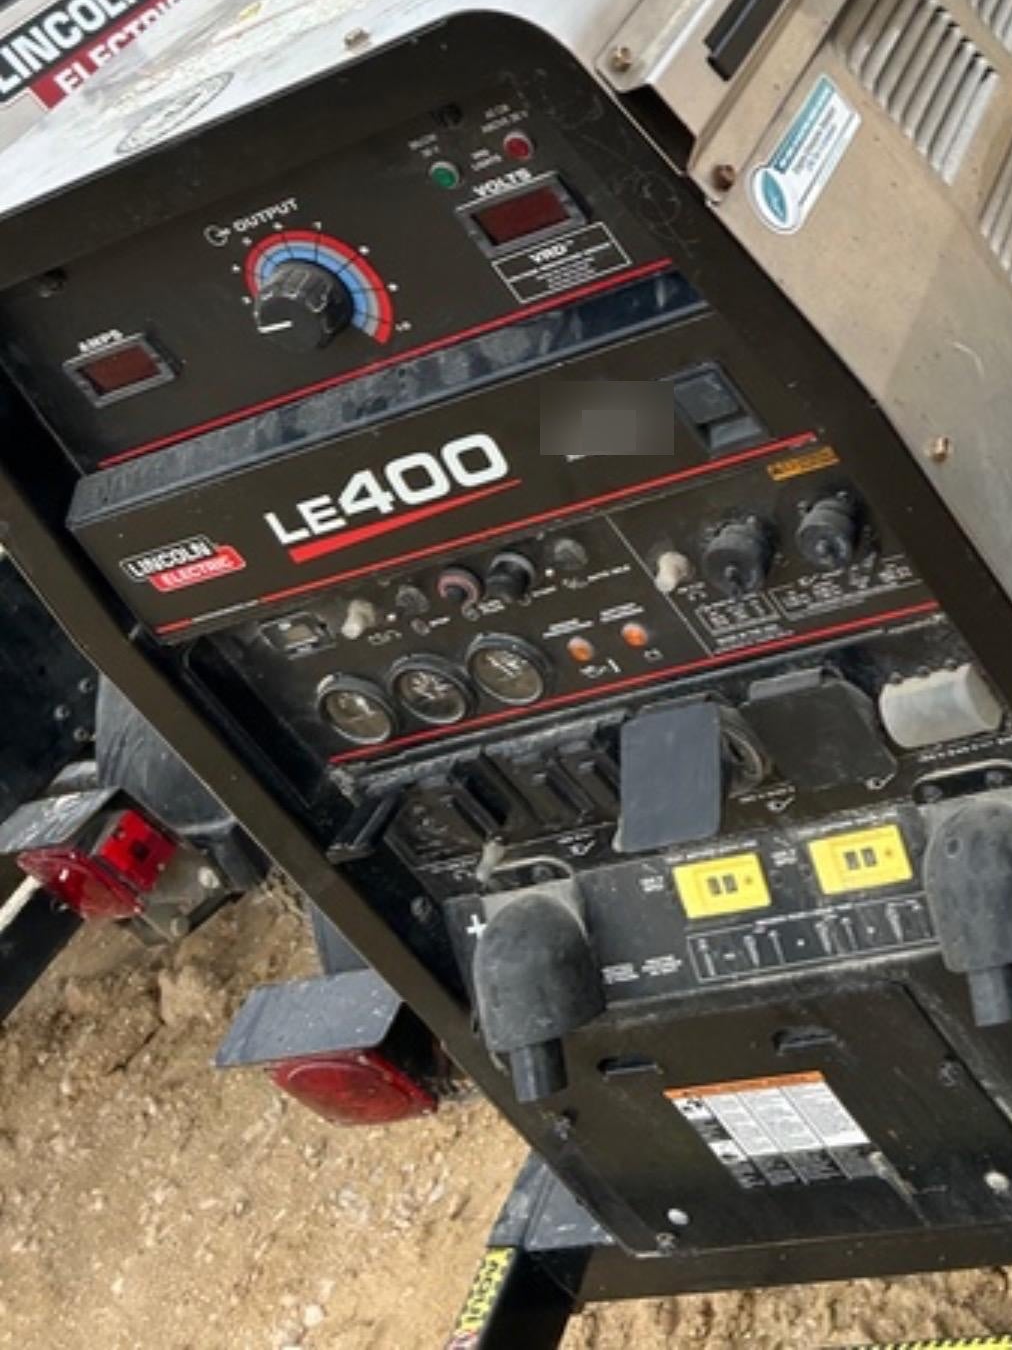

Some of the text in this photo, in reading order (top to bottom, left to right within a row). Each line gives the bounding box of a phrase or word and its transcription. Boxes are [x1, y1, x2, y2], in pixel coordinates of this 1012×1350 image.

[232, 197, 299, 233] OUTPUT
[263, 433, 509, 545] LE400
[129, 538, 213, 578] LINCOLN
[160, 555, 235, 587] ELECTRIC
